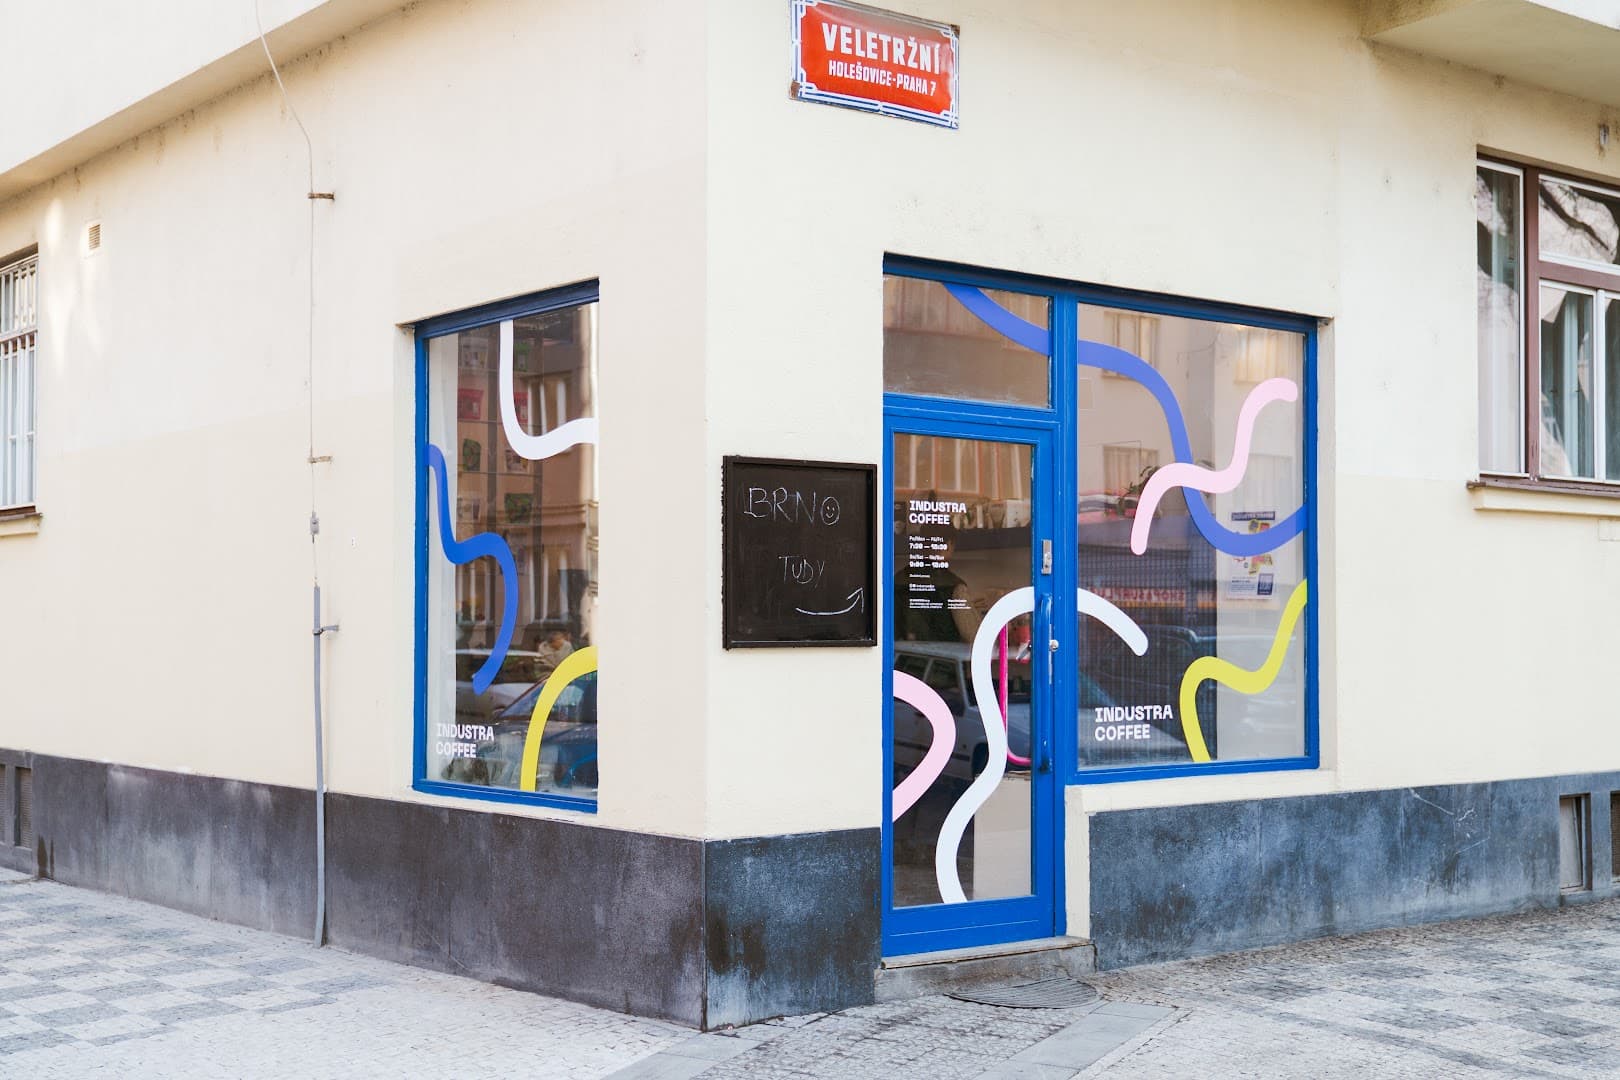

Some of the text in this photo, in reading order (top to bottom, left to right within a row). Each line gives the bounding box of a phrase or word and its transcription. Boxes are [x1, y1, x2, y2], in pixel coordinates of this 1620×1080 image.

[821, 22, 942, 75] VELETRŽNÍ
[930, 81, 937, 97] 7
[909, 500, 967, 514] INDUSTRA
[909, 513, 951, 526] COFFEE
[1095, 704, 1173, 723] INDUSTRA
[436, 723, 495, 742] INDUSTRA
[1094, 723, 1151, 742] COFFEE
[436, 741, 477, 759] COFFEE
